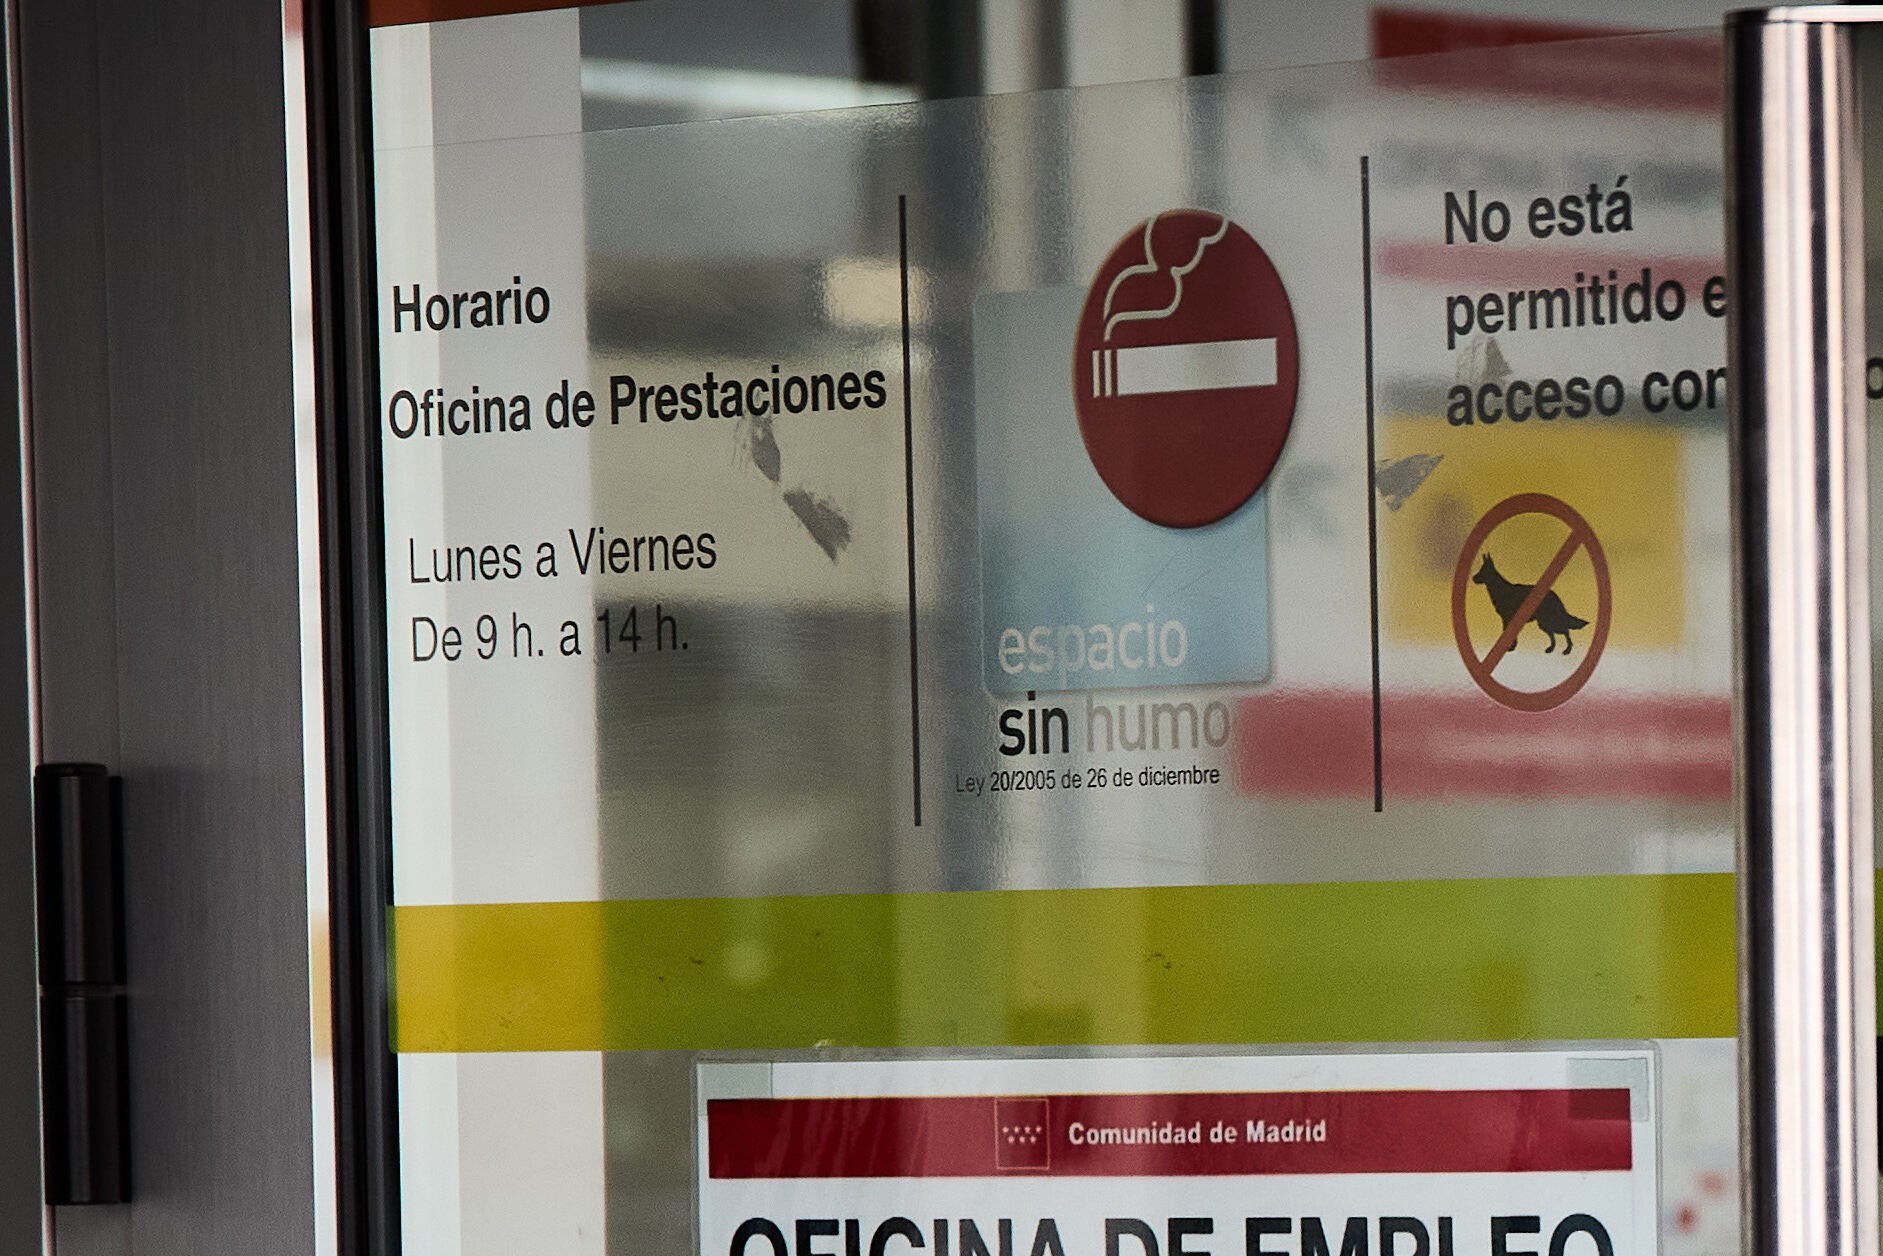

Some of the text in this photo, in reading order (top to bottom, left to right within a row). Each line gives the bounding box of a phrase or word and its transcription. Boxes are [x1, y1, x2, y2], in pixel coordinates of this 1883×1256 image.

[1444, 174, 1633, 245] No está
[392, 275, 551, 333] Horario
[1446, 267, 1727, 351] permitido e
[388, 364, 888, 440] Oficina de Prestaciones
[1446, 366, 1728, 427] acceso con
[409, 526, 717, 584] Lunes a Viernes
[412, 604, 689, 662] De 9 h. a 14 h.
[998, 602, 1188, 690] espacio
[998, 690, 1231, 757] sin humo
[955, 765, 1220, 797] Ley 20/2005 de 26 de diciembre
[1068, 1119, 1327, 1145] Comunidad de Madrid
